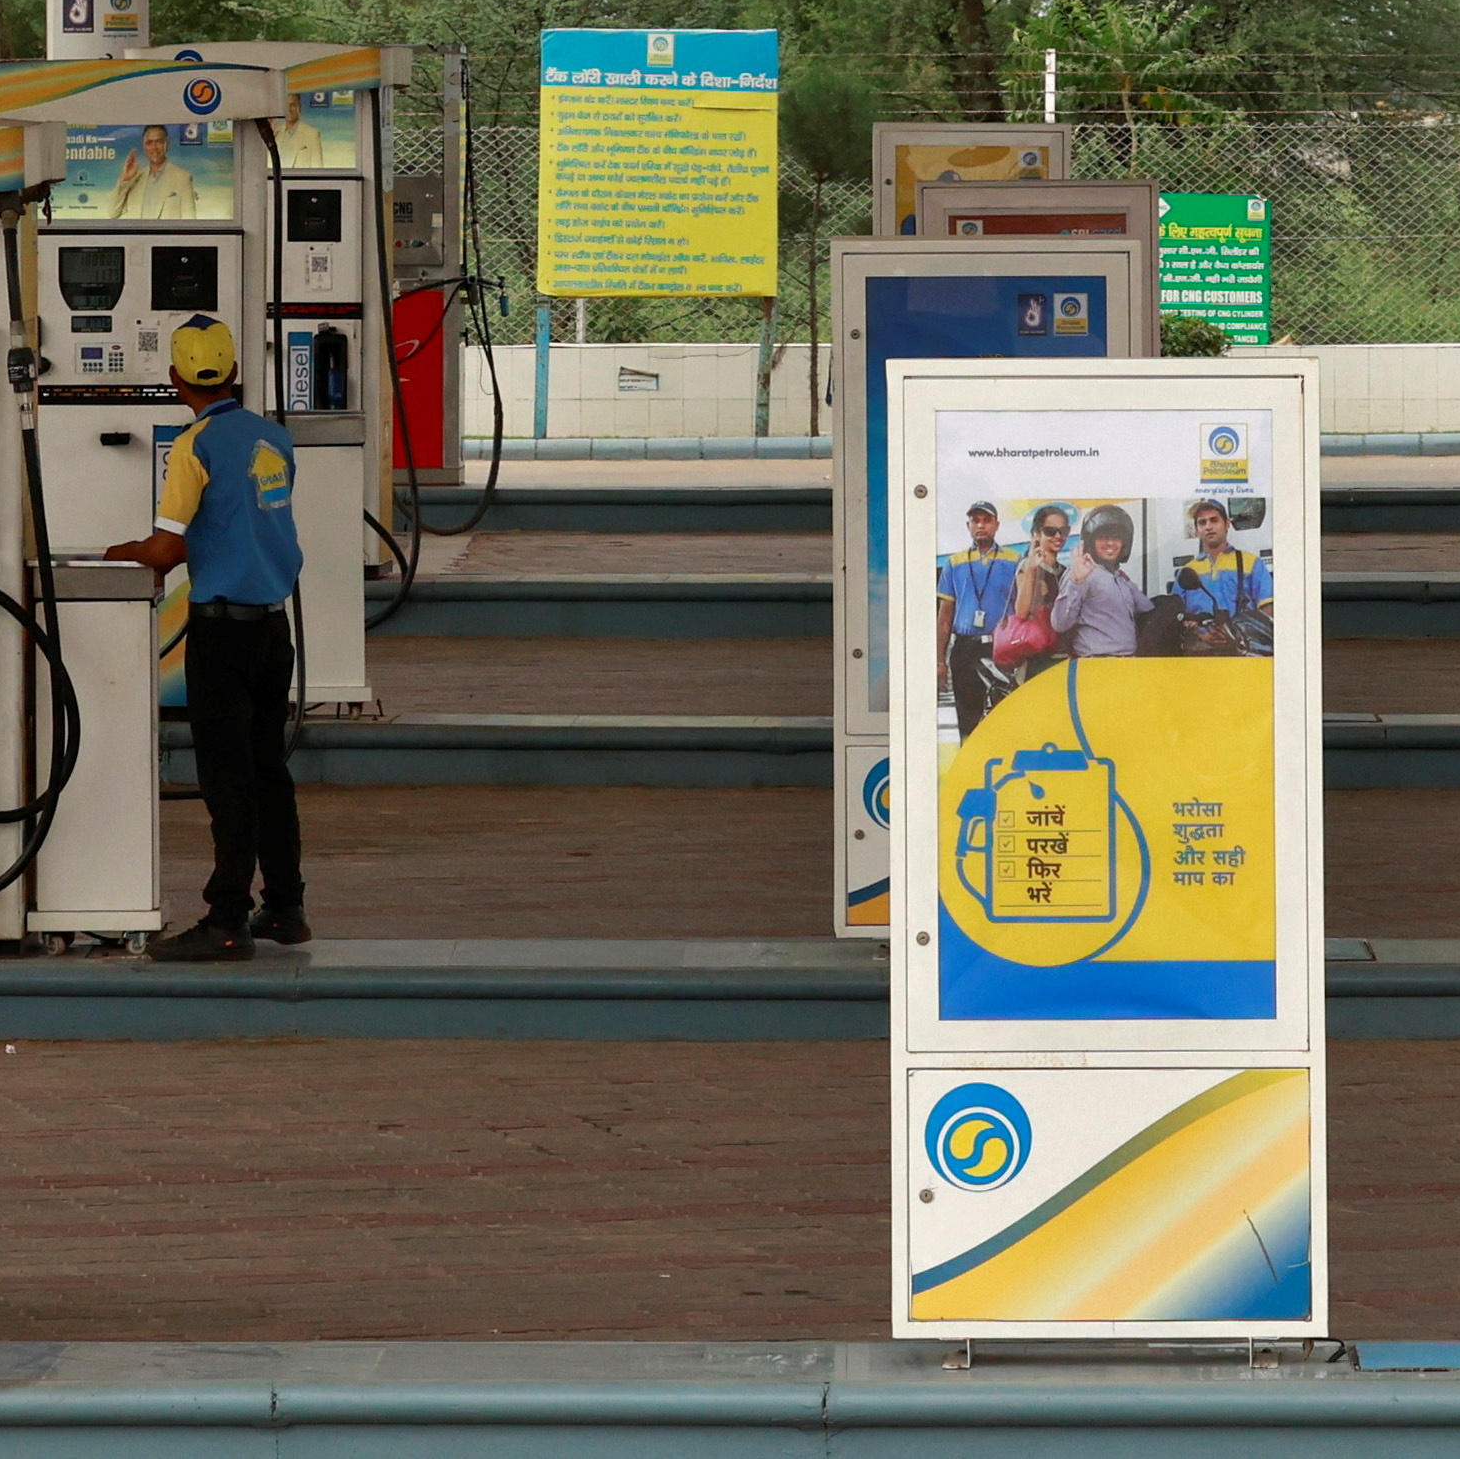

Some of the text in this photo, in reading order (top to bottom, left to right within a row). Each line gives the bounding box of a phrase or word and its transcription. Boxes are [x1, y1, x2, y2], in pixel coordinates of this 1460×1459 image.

[572, 67, 602, 84] लॉरी
[605, 68, 642, 86] खाली
[645, 70, 678, 87] करने
[681, 71, 696, 87] के
[85, 134, 98, 144] Ka
[1161, 290, 1263, 304] FOR CNG CUSTOMERS
[968, 446, 1100, 460] www.bharatpetroleum.in
[1202, 467, 1247, 476] Petroleum
[1210, 460, 1239, 469] Bharat
[1026, 804, 1066, 828] जांचें
[1172, 797, 1223, 818] भरोसा
[1026, 831, 1069, 856] परखें
[1172, 823, 1224, 844] शुद्धता
[1172, 844, 1246, 866] और सही
[1027, 857, 1062, 880] फिर
[1172, 870, 1235, 886] माप का
[1027, 881, 1053, 904] भरें
